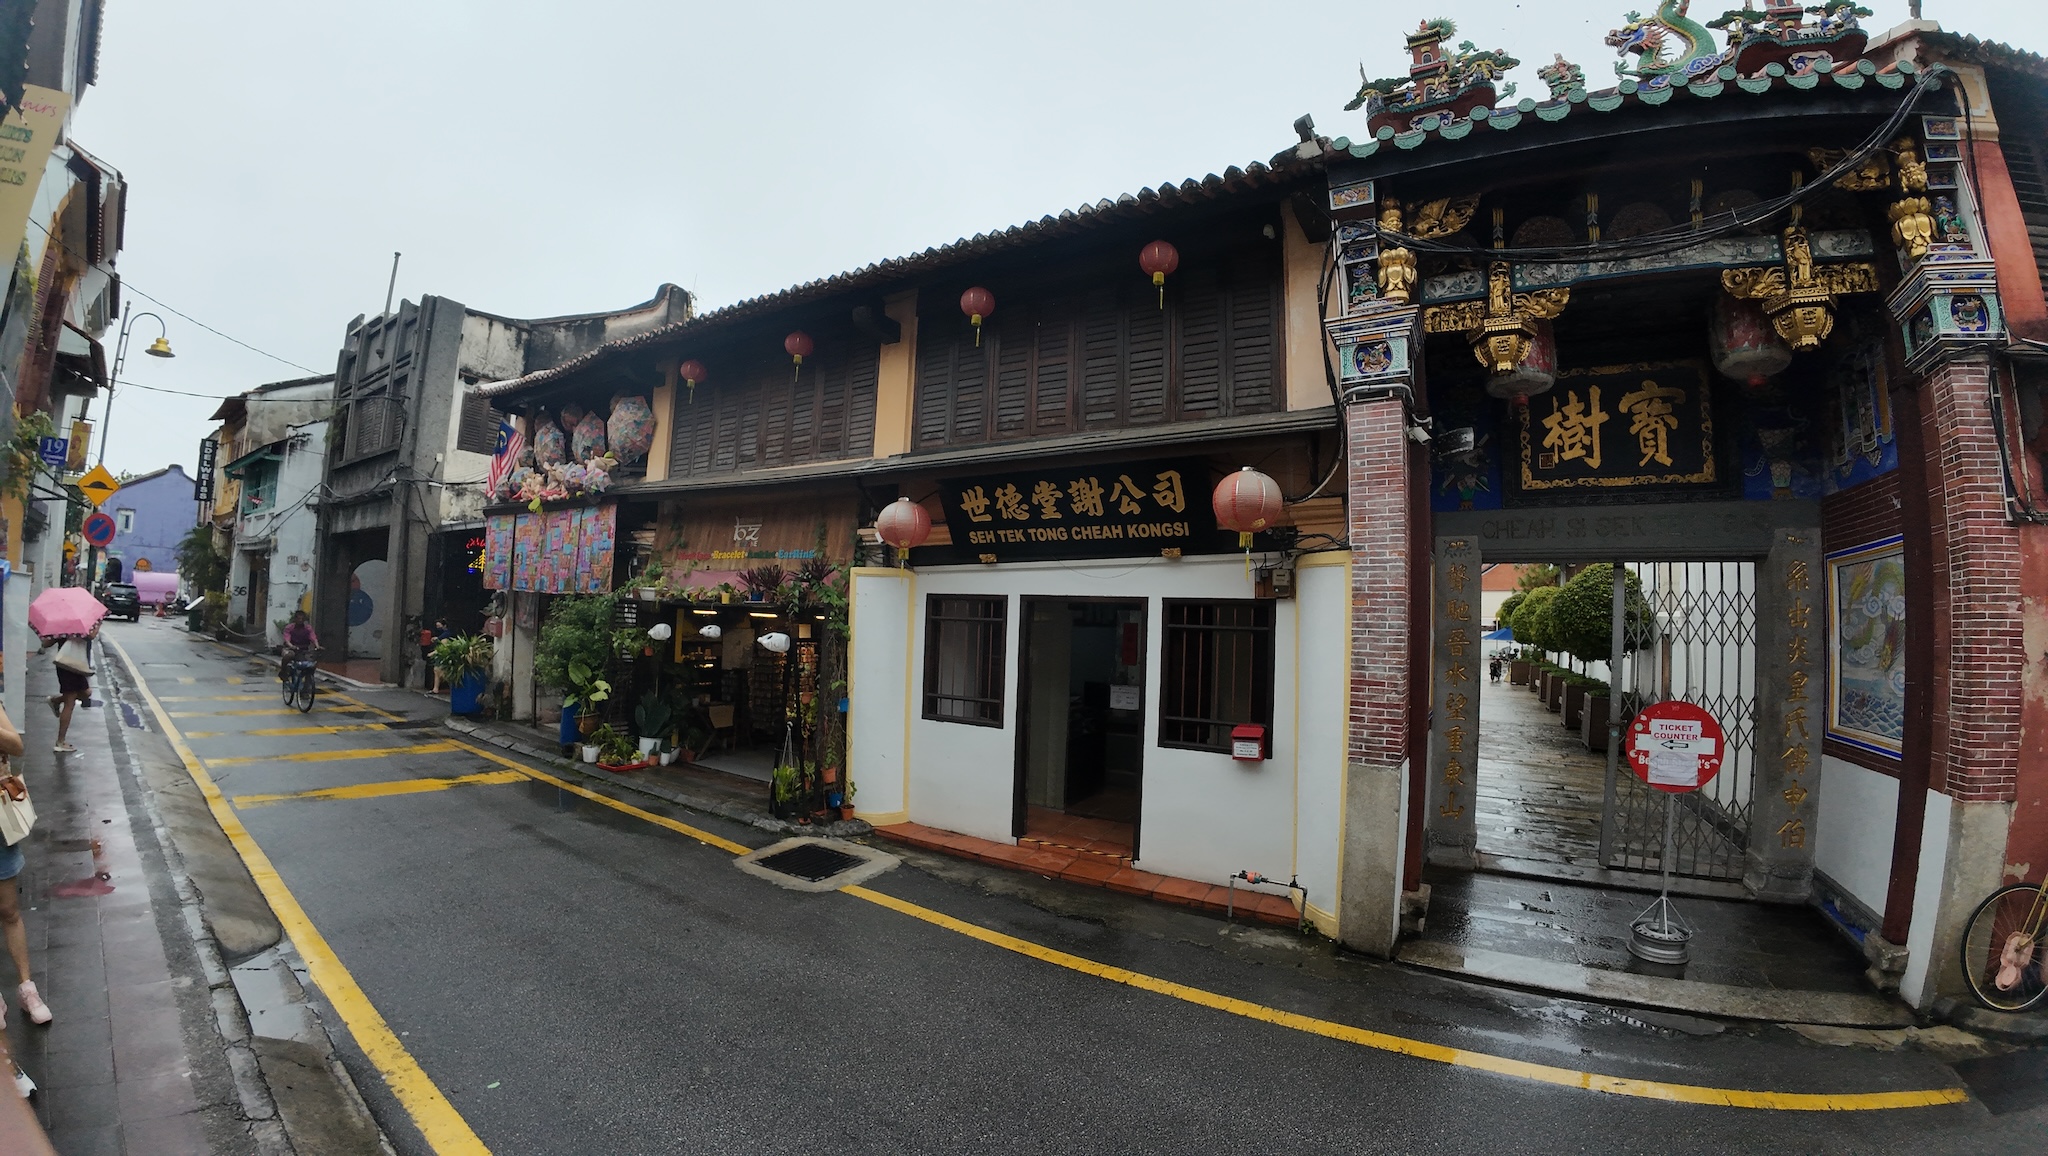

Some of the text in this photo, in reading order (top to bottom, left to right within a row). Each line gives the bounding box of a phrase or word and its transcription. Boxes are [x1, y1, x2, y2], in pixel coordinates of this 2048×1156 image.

[45, 439, 65, 453] 19
[199, 440, 213, 500] EDELWEISS
[960, 470, 1187, 523] 世德堂謝公司
[968, 521, 1190, 545] SEH TEK TONG CHEAH KONGSI
[1482, 517, 1556, 540] CHEAH
[1595, 515, 1646, 538] SEK
[713, 550, 745, 560] Bracelet
[233, 585, 248, 597] 36
[1659, 723, 1694, 732] TICKET
[1653, 732, 1698, 741] COUNTER
